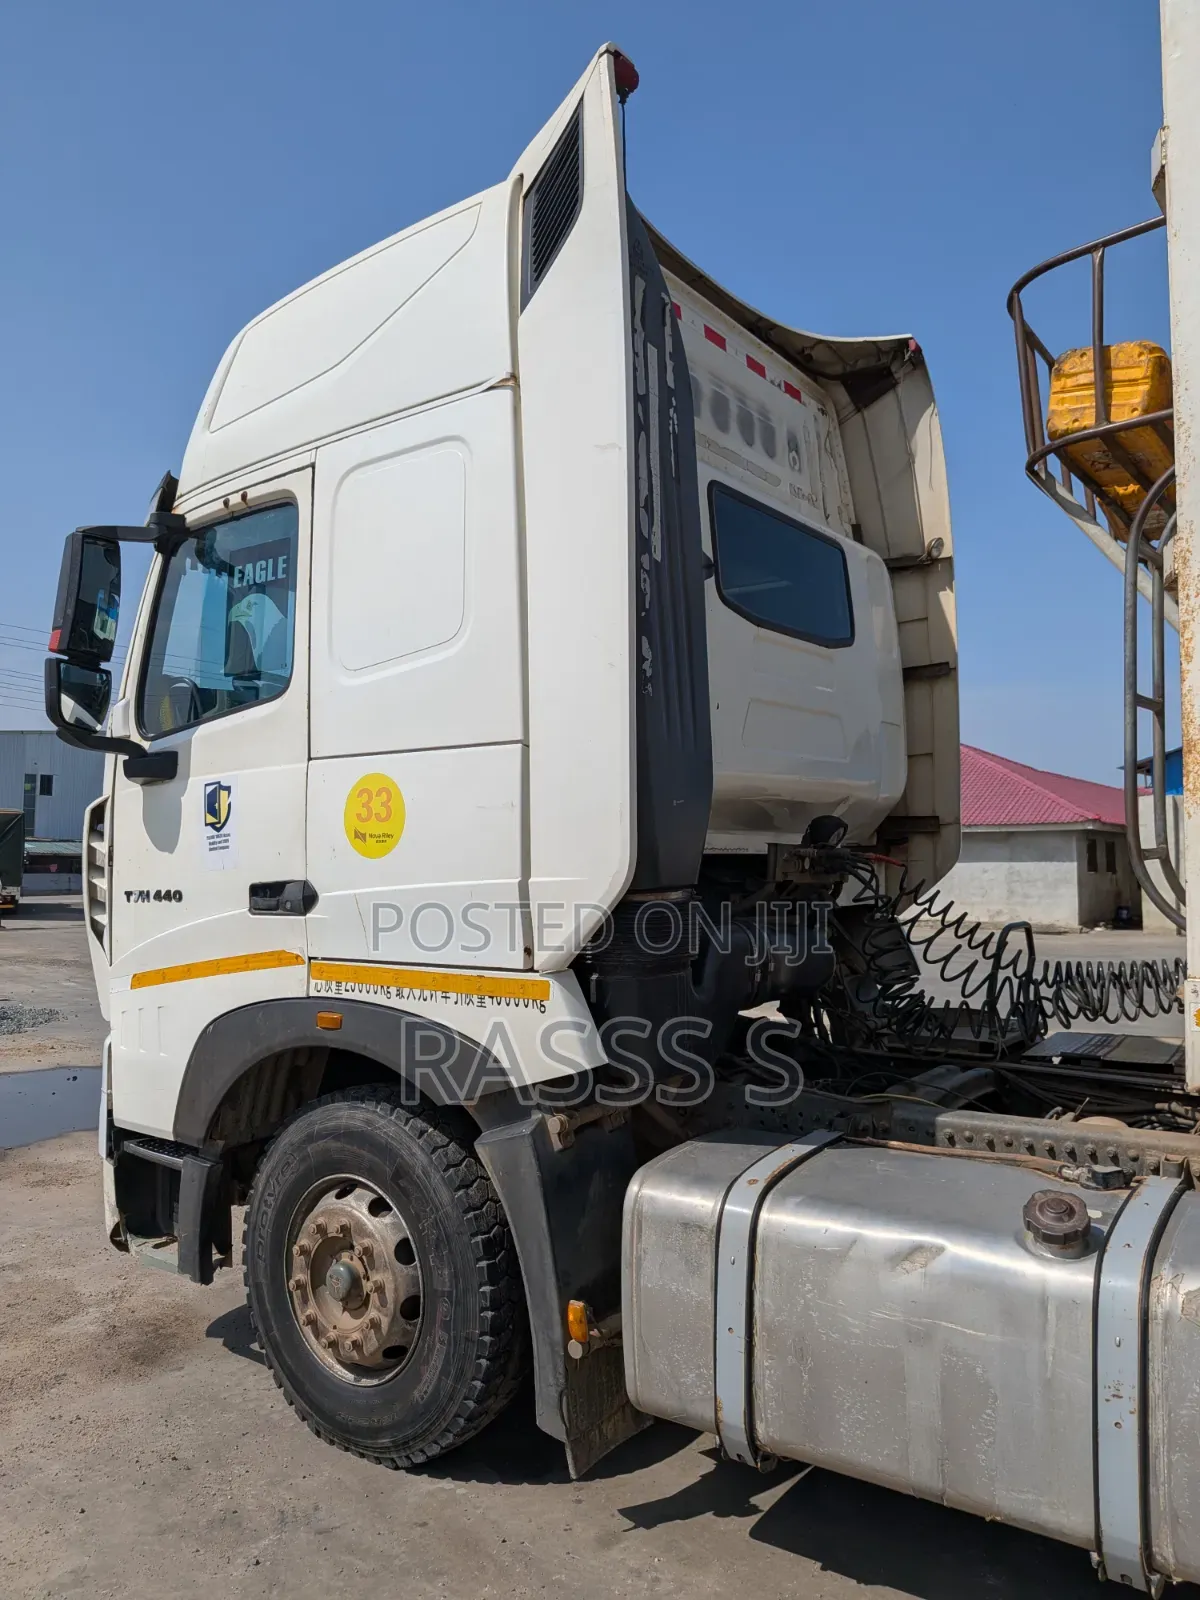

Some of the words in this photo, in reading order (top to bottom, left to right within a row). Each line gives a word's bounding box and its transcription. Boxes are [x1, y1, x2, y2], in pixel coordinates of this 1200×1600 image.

[234, 555, 288, 588] EAGLE
[356, 787, 392, 823] 33
[153, 889, 183, 903] 440
